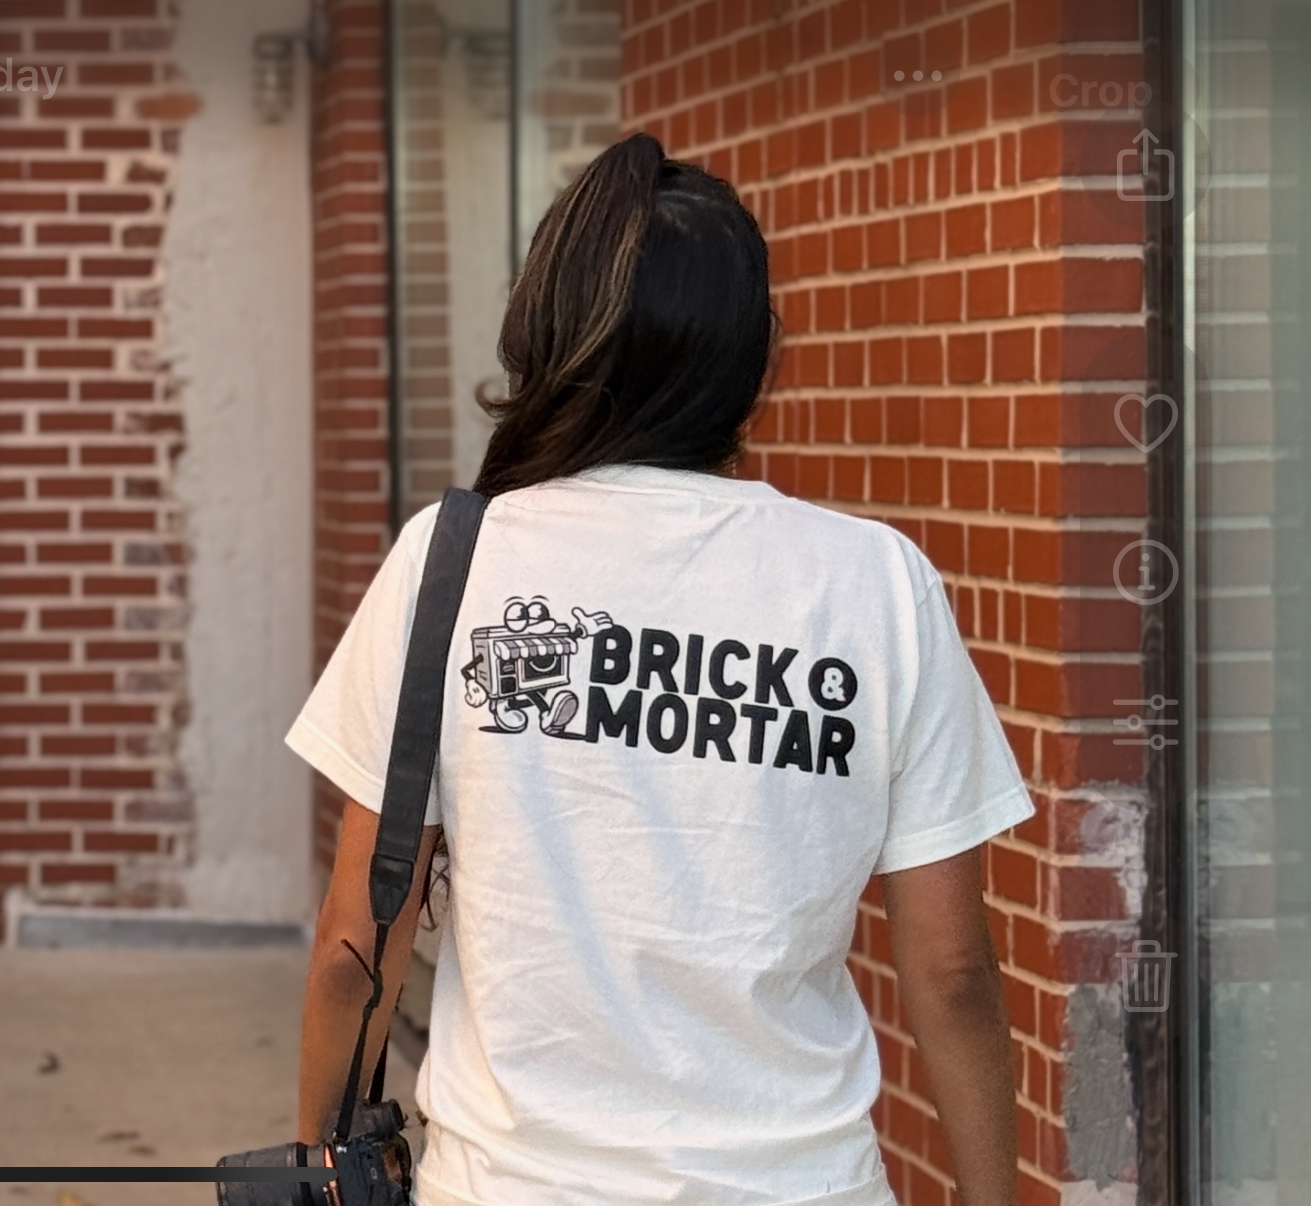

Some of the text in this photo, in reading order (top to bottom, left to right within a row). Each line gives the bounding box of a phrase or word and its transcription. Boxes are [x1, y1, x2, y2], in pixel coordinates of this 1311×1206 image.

[589, 624, 850, 708] BRICK &
[586, 685, 856, 777] MORTAR
